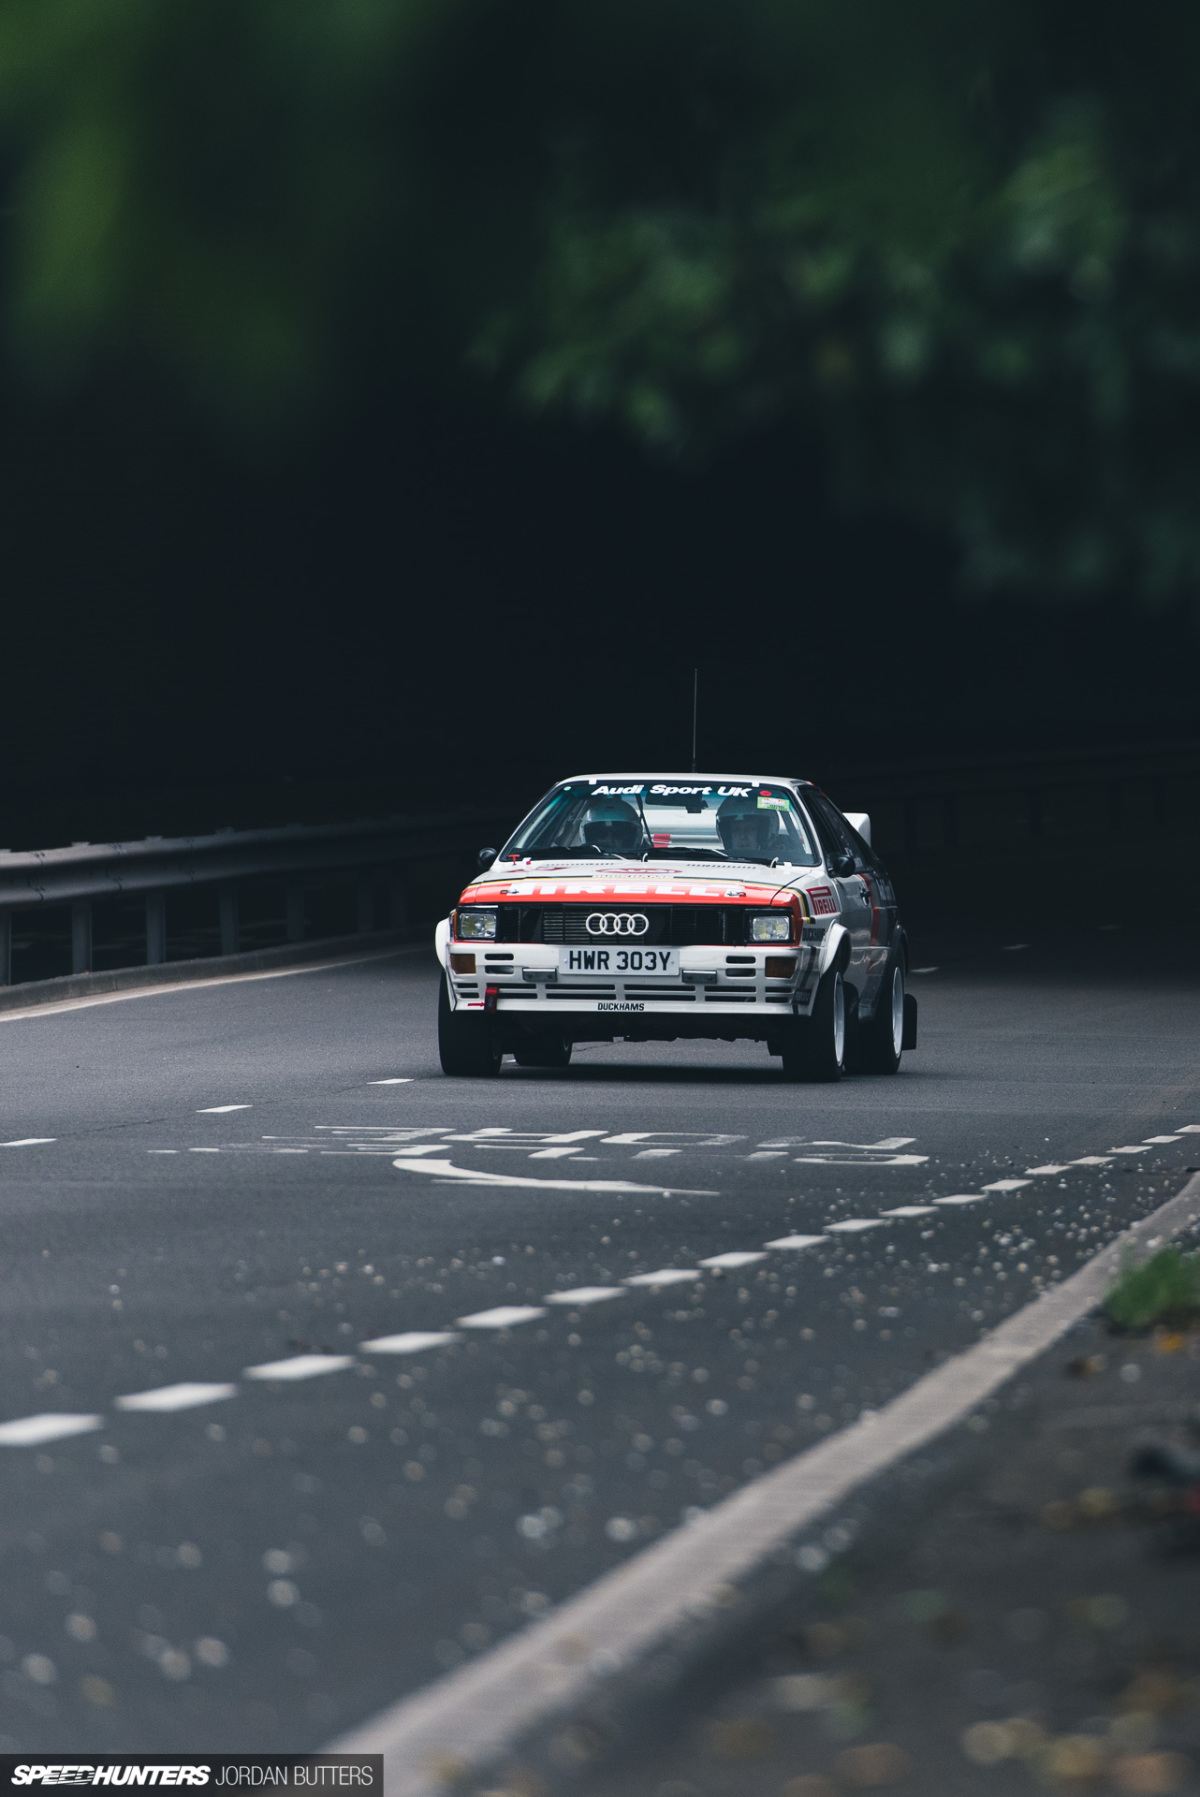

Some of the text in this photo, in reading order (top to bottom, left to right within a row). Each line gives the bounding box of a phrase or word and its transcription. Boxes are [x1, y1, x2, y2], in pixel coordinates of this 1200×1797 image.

[591, 784, 752, 798] Audi Sport UK
[806, 886, 838, 915] PIRELLI
[569, 950, 671, 971] HWR 303Y
[597, 1002, 645, 1012] DUCKHAMS
